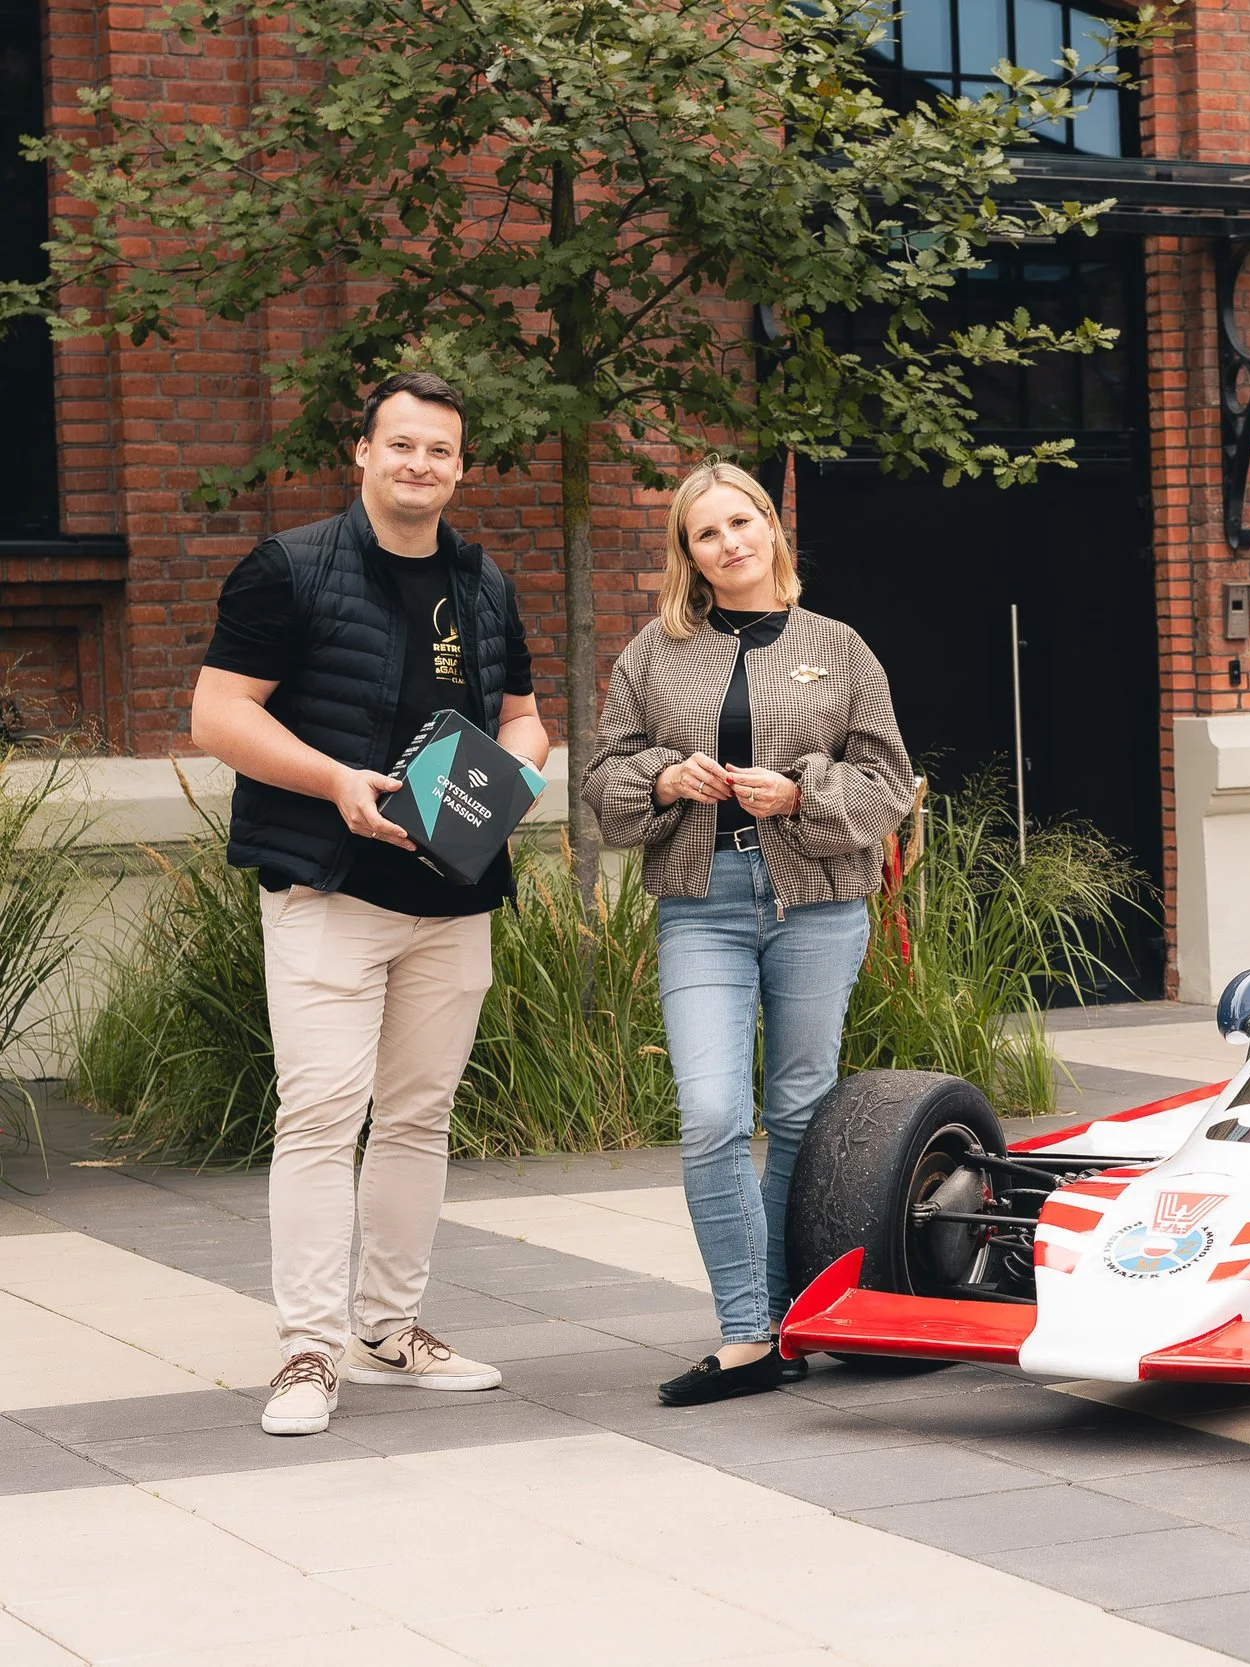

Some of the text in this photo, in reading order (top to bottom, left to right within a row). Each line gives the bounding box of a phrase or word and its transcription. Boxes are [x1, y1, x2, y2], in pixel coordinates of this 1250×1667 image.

[431, 787, 444, 800] IN
[443, 795, 483, 828] PASSION
[437, 775, 492, 819] CRYSTALIZED
